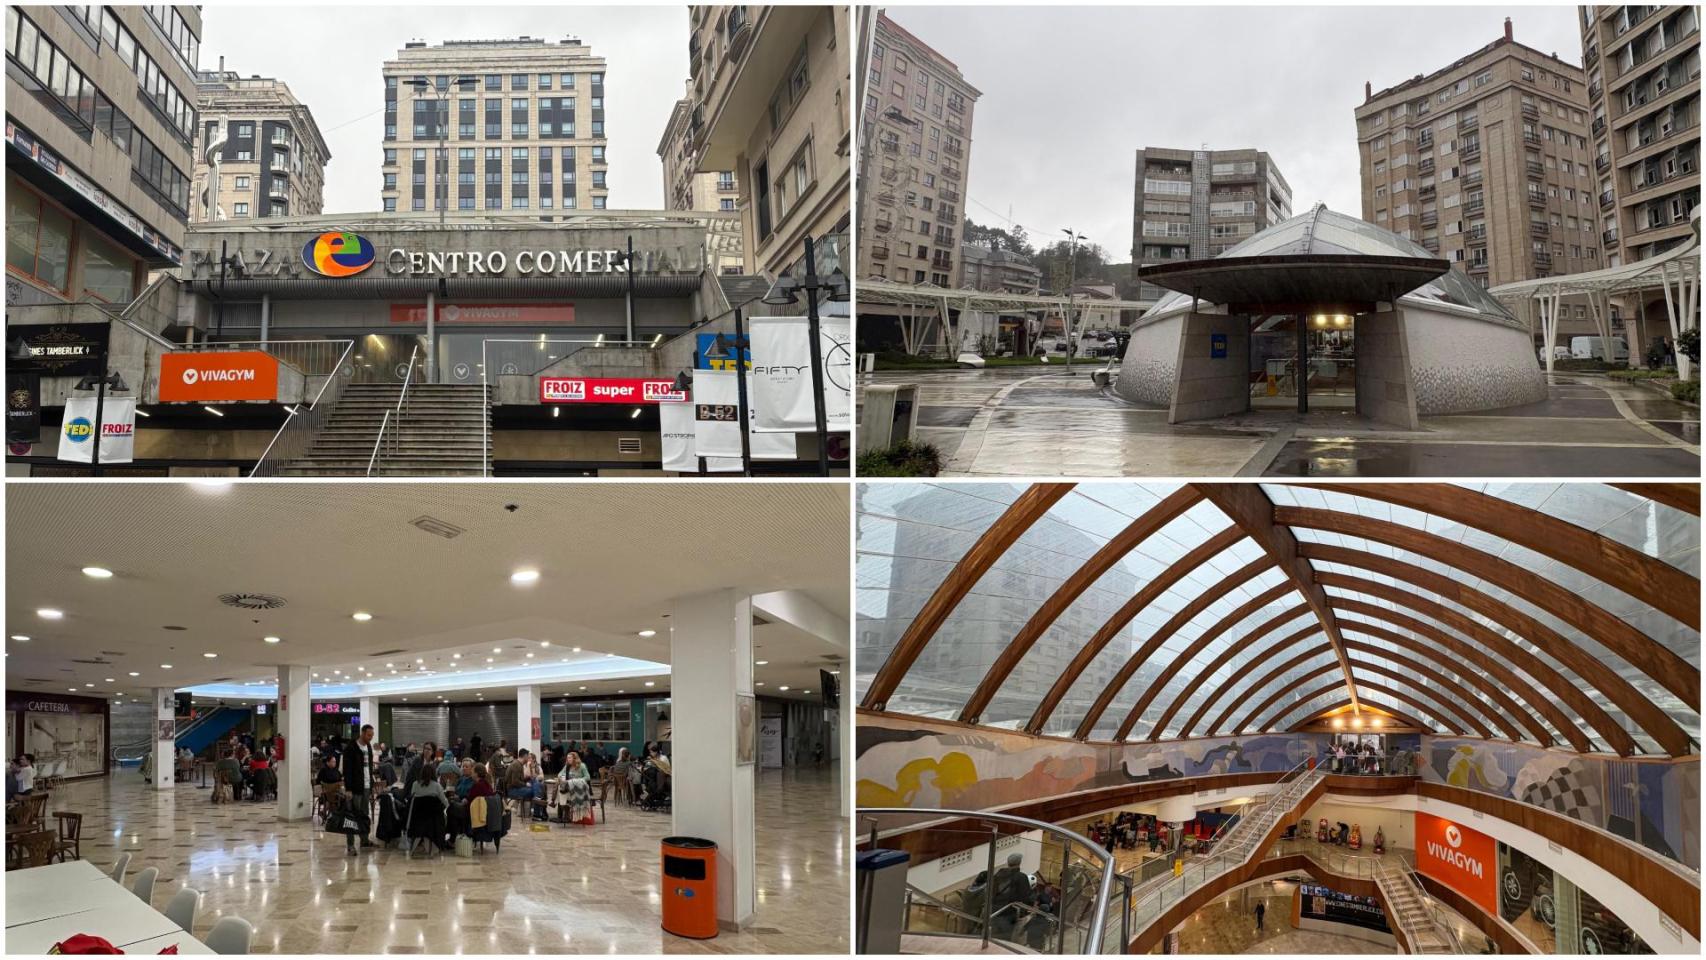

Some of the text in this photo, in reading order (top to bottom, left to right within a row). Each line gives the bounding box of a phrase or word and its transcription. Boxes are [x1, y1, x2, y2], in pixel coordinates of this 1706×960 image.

[46, 345, 83, 356] TAMBERLICK
[200, 369, 255, 381] VIVAGYM
[754, 365, 809, 375] FIFTY
[545, 382, 582, 394] FROIZ
[593, 385, 635, 398] super
[700, 405, 735, 420] B-52
[102, 423, 133, 434] FROIZ
[28, 700, 70, 713] CAFETERIA
[1427, 840, 1483, 880] VIVAGYM
